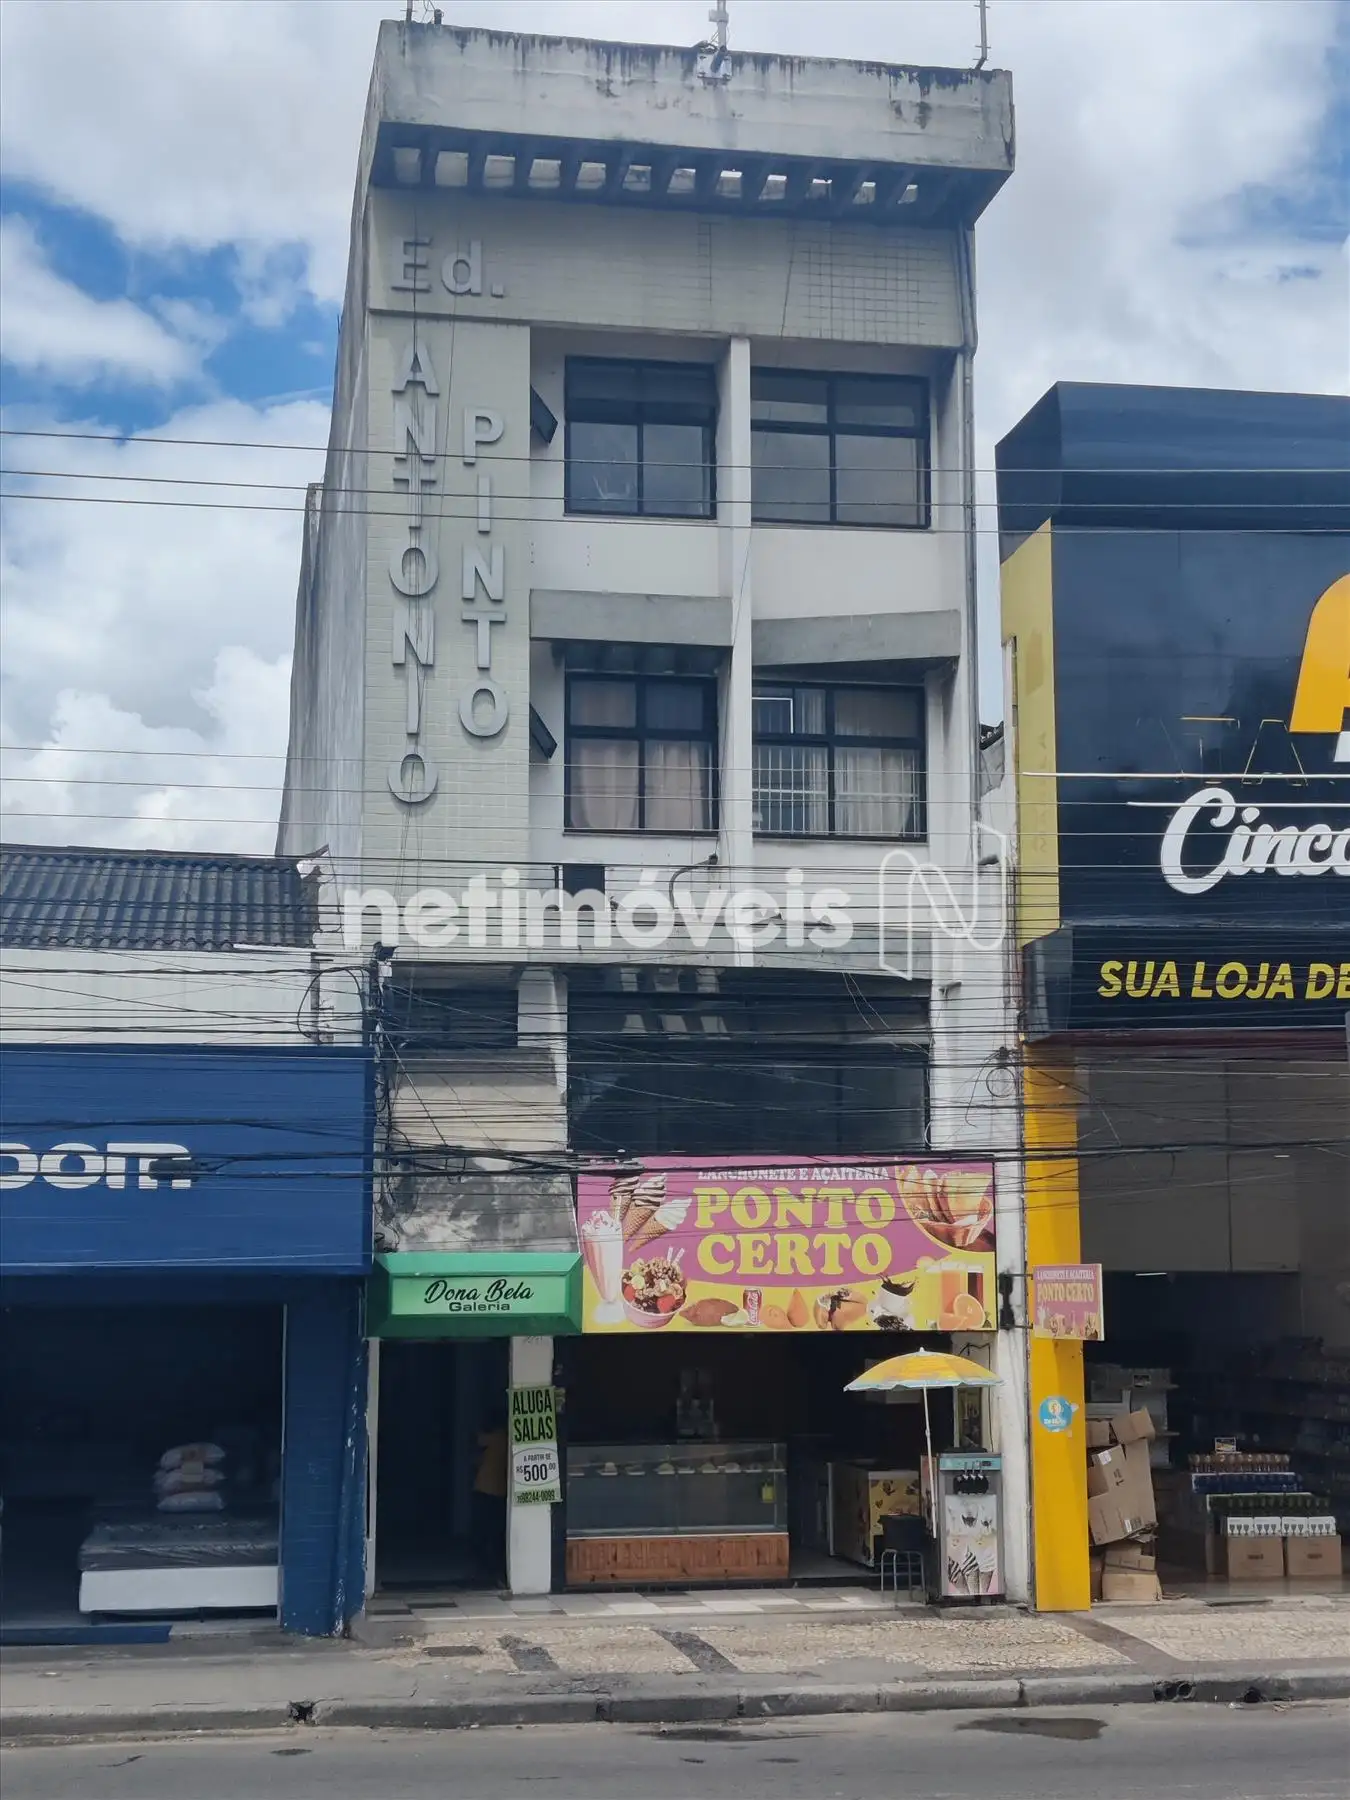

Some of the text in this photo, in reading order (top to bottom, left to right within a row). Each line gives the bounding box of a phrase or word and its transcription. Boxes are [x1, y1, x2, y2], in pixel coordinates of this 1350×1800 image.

[390, 236, 504, 297] Ed.
[388, 340, 440, 805] ANTONIO
[457, 408, 509, 738] PINTO
[1096, 960, 1181, 998] SUA
[1190, 961, 1295, 999] LOJA
[797, 1168, 809, 1181] E
[692, 1187, 896, 1229] PONTO
[697, 1233, 893, 1275] CERTO
[424, 1278, 535, 1304] Dona Bela
[448, 1301, 511, 1312] Galeria
[512, 1388, 553, 1415] ALUGA
[513, 1416, 554, 1442] SALAS
